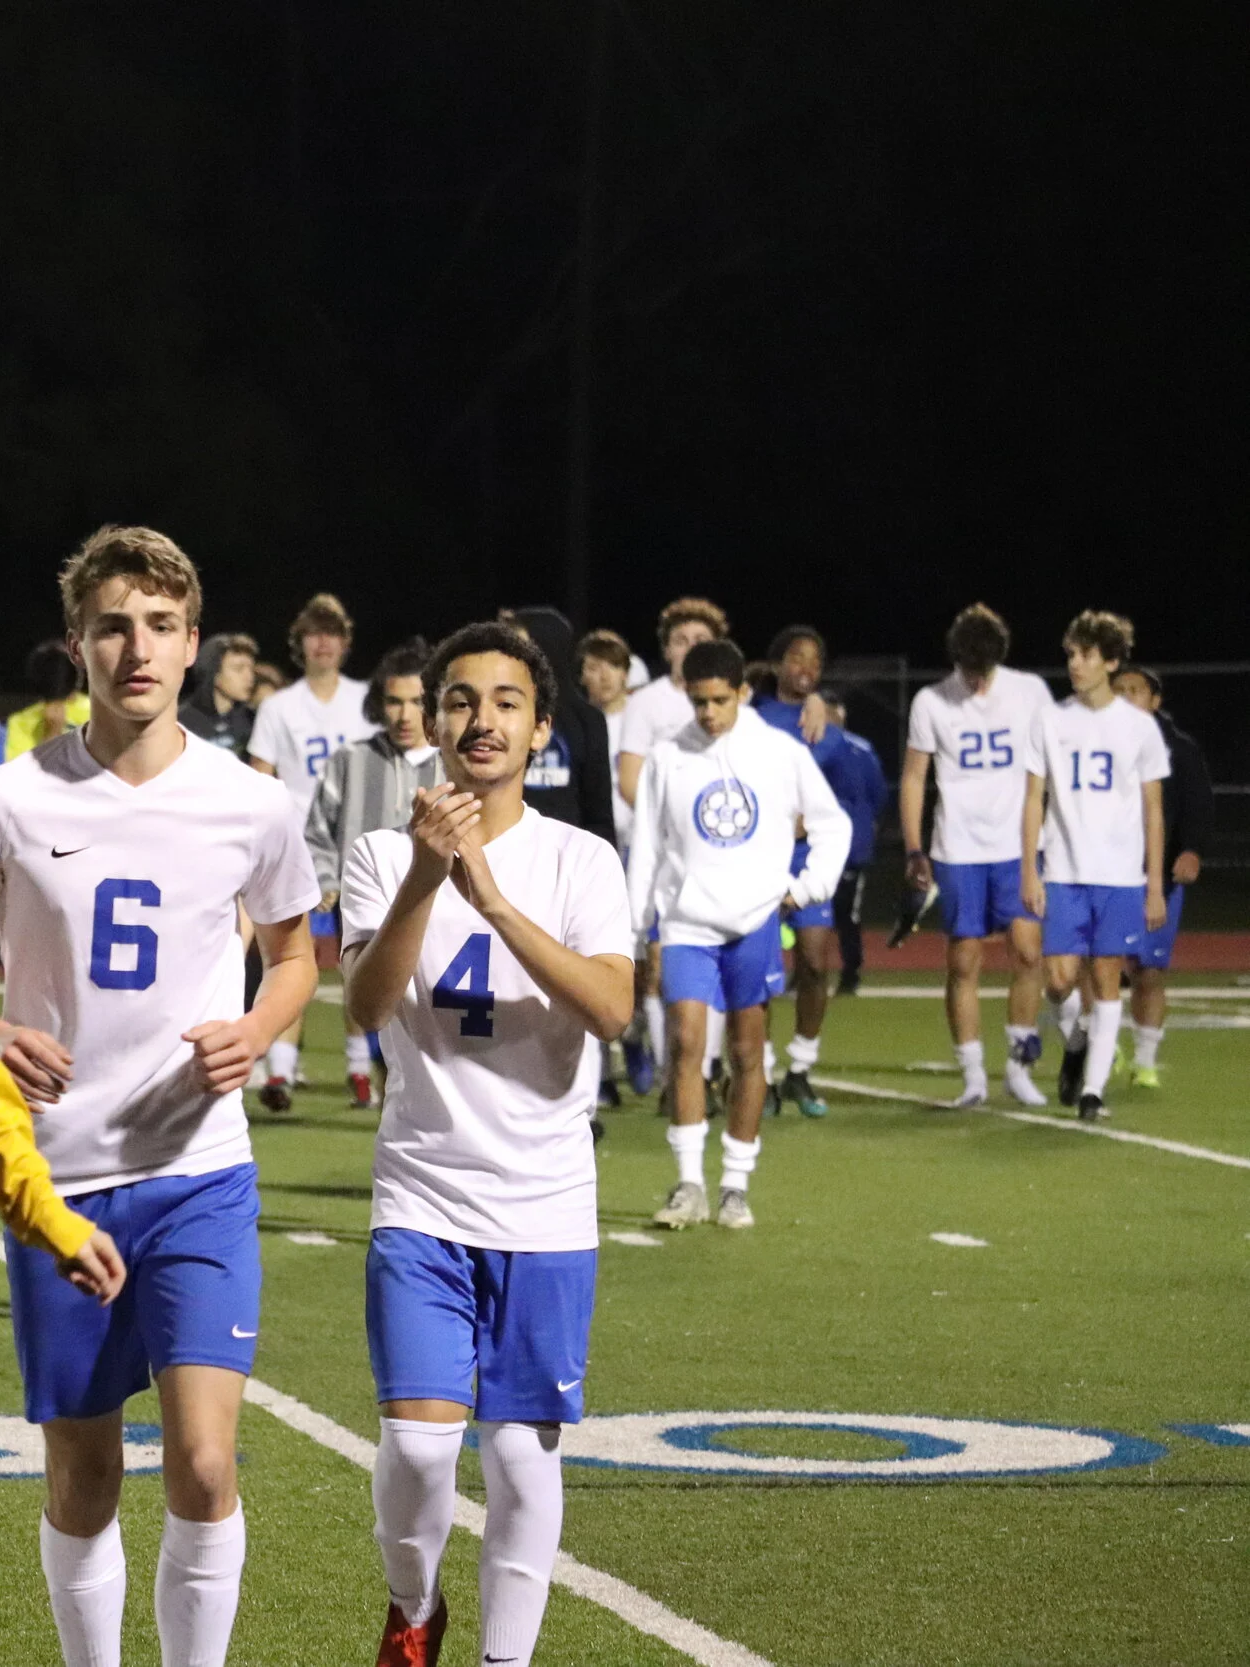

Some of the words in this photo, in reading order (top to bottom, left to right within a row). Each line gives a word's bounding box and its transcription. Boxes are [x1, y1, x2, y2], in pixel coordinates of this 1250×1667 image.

[306, 735, 345, 776] 2
[959, 729, 1014, 769] 25
[1070, 750, 1113, 791] 13
[89, 878, 161, 991] 6
[432, 932, 495, 1037] 4
